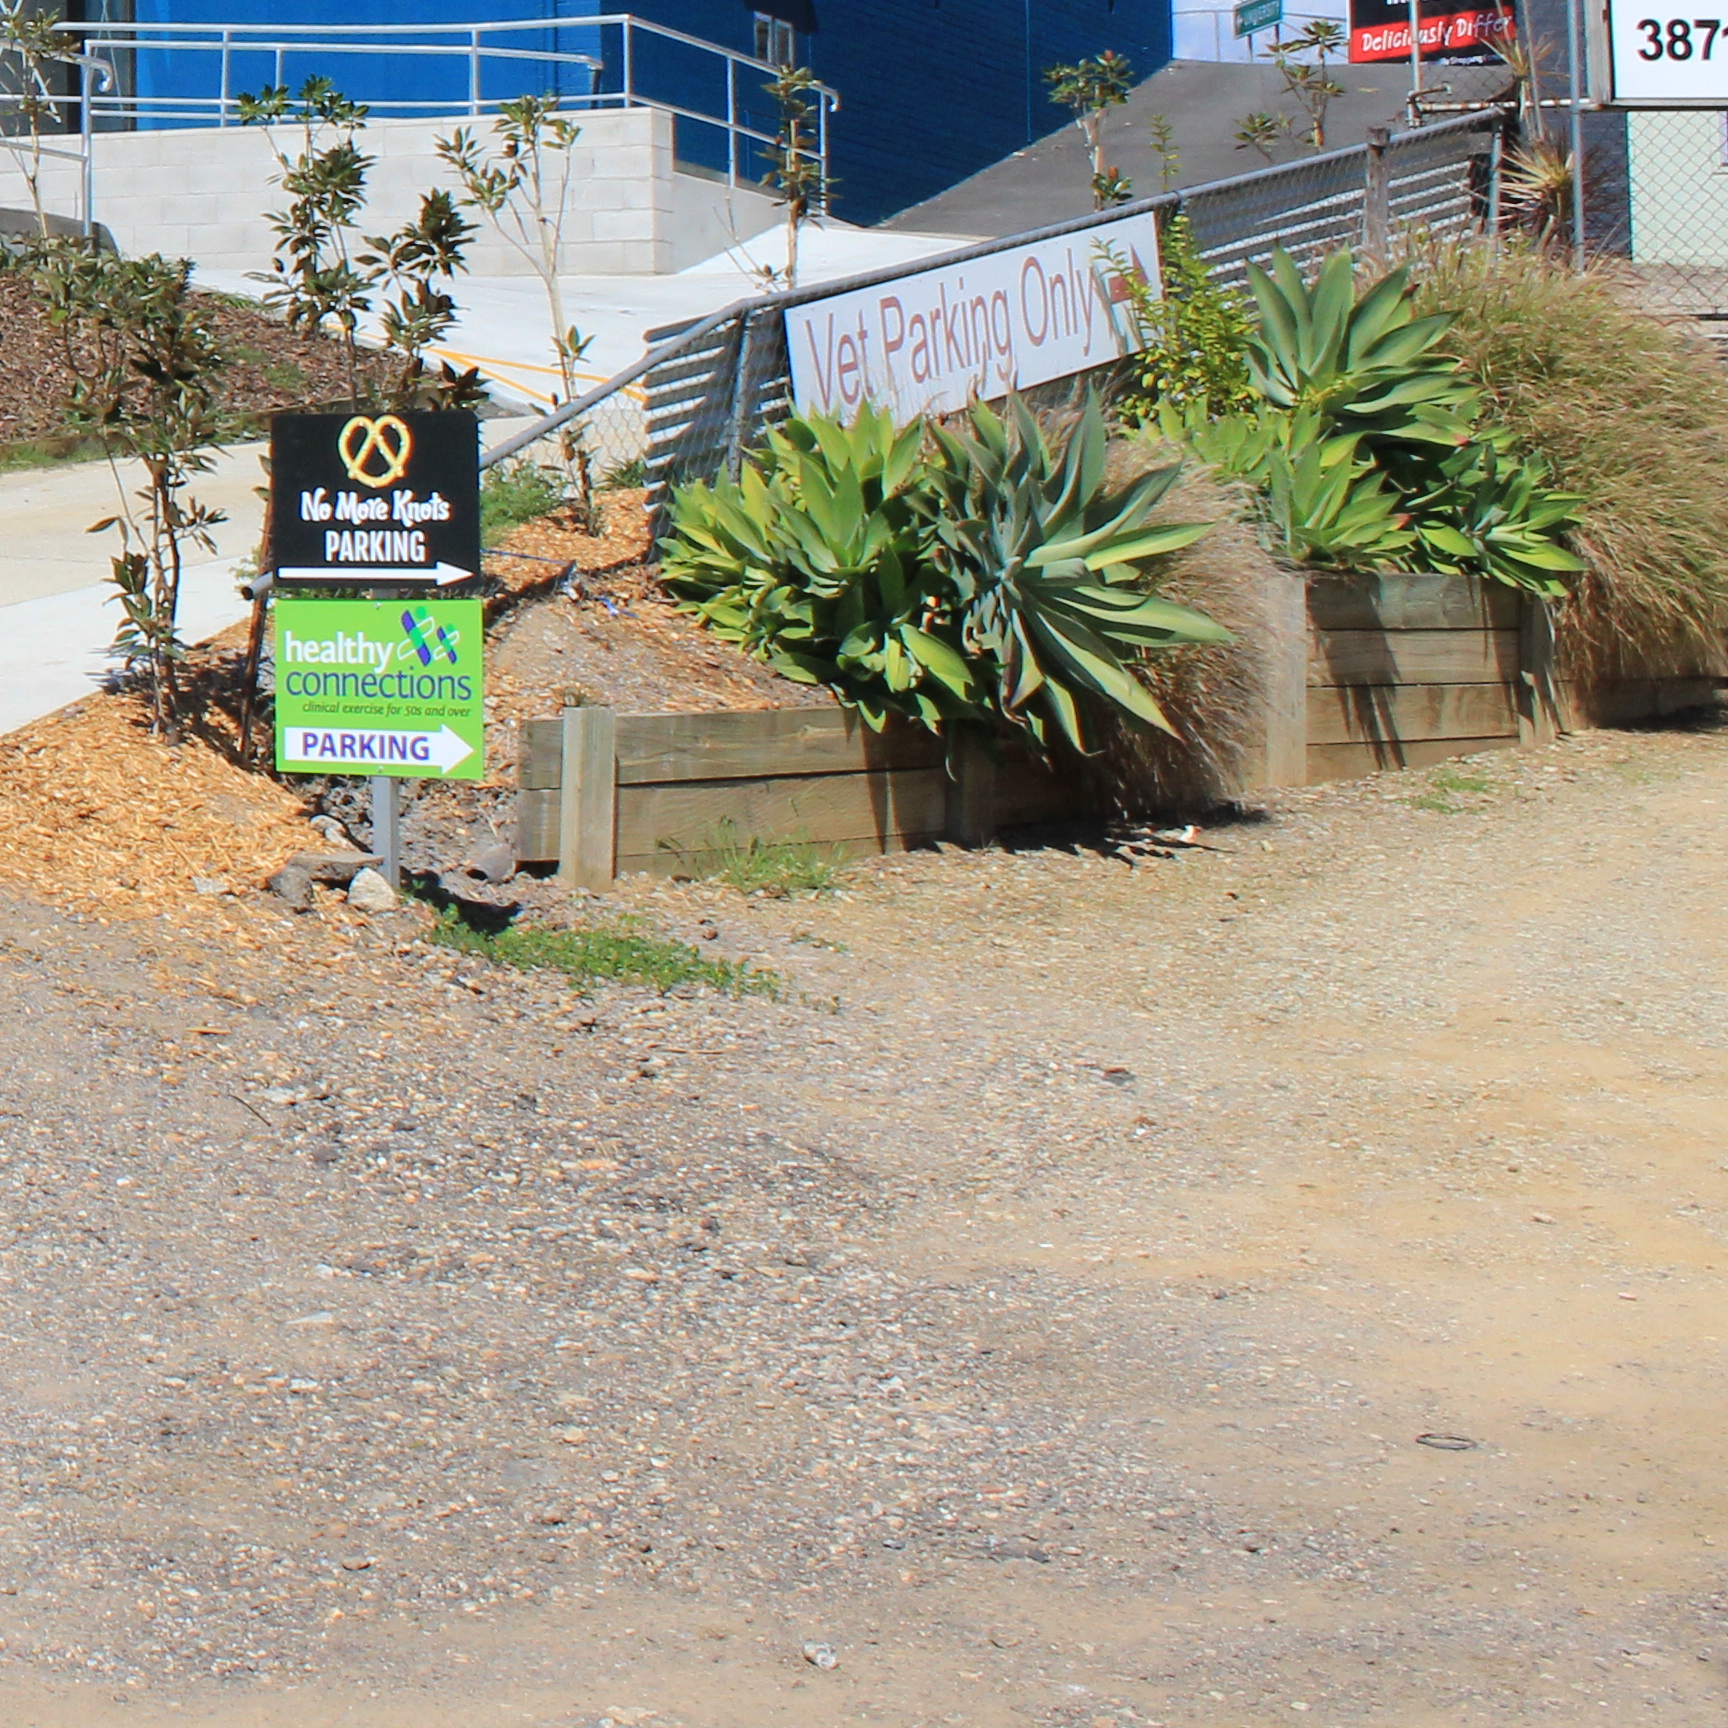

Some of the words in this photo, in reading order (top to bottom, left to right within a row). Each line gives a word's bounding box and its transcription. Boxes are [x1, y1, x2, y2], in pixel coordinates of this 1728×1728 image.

[805, 309, 873, 413] Vet
[879, 277, 1014, 389] Parking
[1021, 247, 1095, 357] Only
[300, 487, 333, 522] No
[335, 490, 390, 526] More
[391, 488, 452, 528] Knots
[325, 529, 427, 563] PARKING
[284, 630, 394, 674] healthy
[286, 666, 473, 701] connections
[302, 701, 340, 714] clinical
[342, 703, 385, 715] exercise
[385, 702, 402, 718] for
[404, 705, 422, 717] 50s
[424, 704, 445, 717] and
[447, 706, 472, 718] over
[302, 731, 431, 762] PARKING
